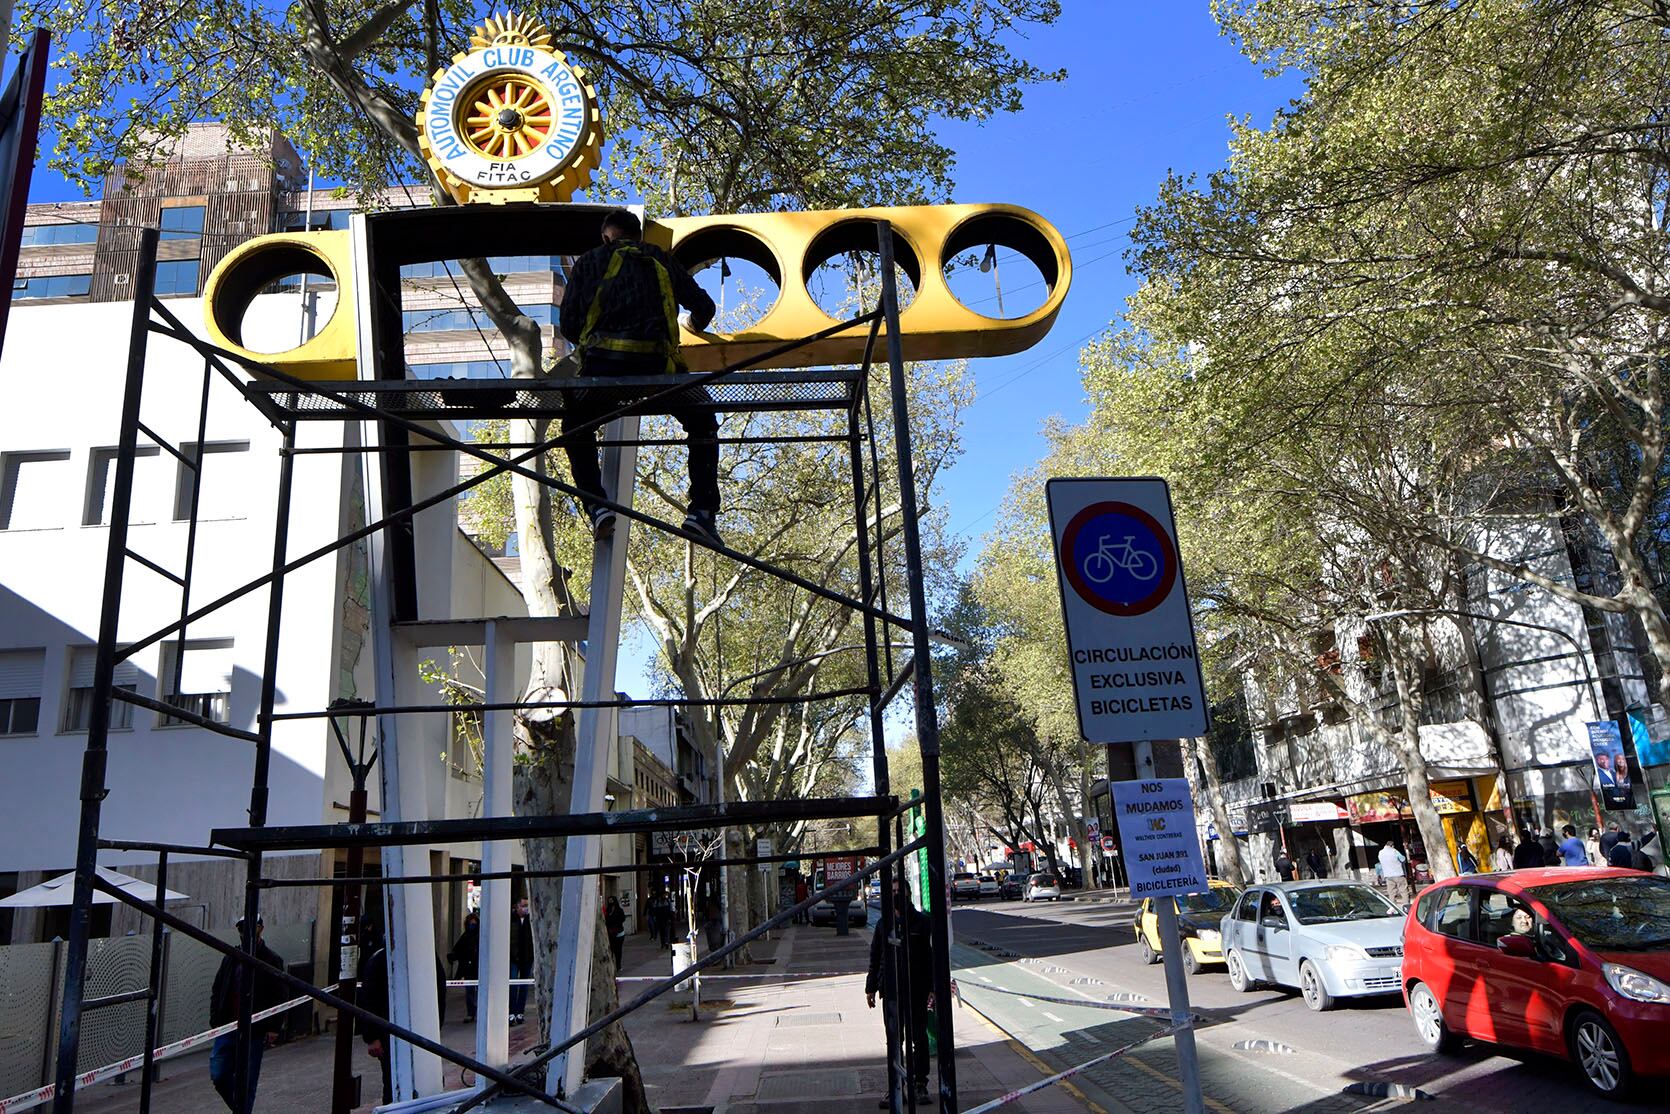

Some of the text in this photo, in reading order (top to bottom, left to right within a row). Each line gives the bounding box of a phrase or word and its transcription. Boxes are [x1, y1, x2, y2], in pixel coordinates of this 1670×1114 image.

[429, 48, 582, 160] AUTOMOVIL CLUB ARGENTINO
[489, 163, 516, 171] FIA
[477, 170, 531, 182] FITAC
[1074, 643, 1193, 664] CIRCULACIÓN
[1090, 671, 1185, 689] EXCLUSIVA
[1091, 696, 1193, 715] BICICLETAS
[1141, 782, 1163, 793] NOS
[1126, 800, 1184, 814] MUDAMOS
[1139, 852, 1155, 862] SAN
[1156, 851, 1175, 860] JUAN
[1152, 864, 1181, 875] (ciudad)
[1136, 875, 1198, 892] BICICLETERÍA
